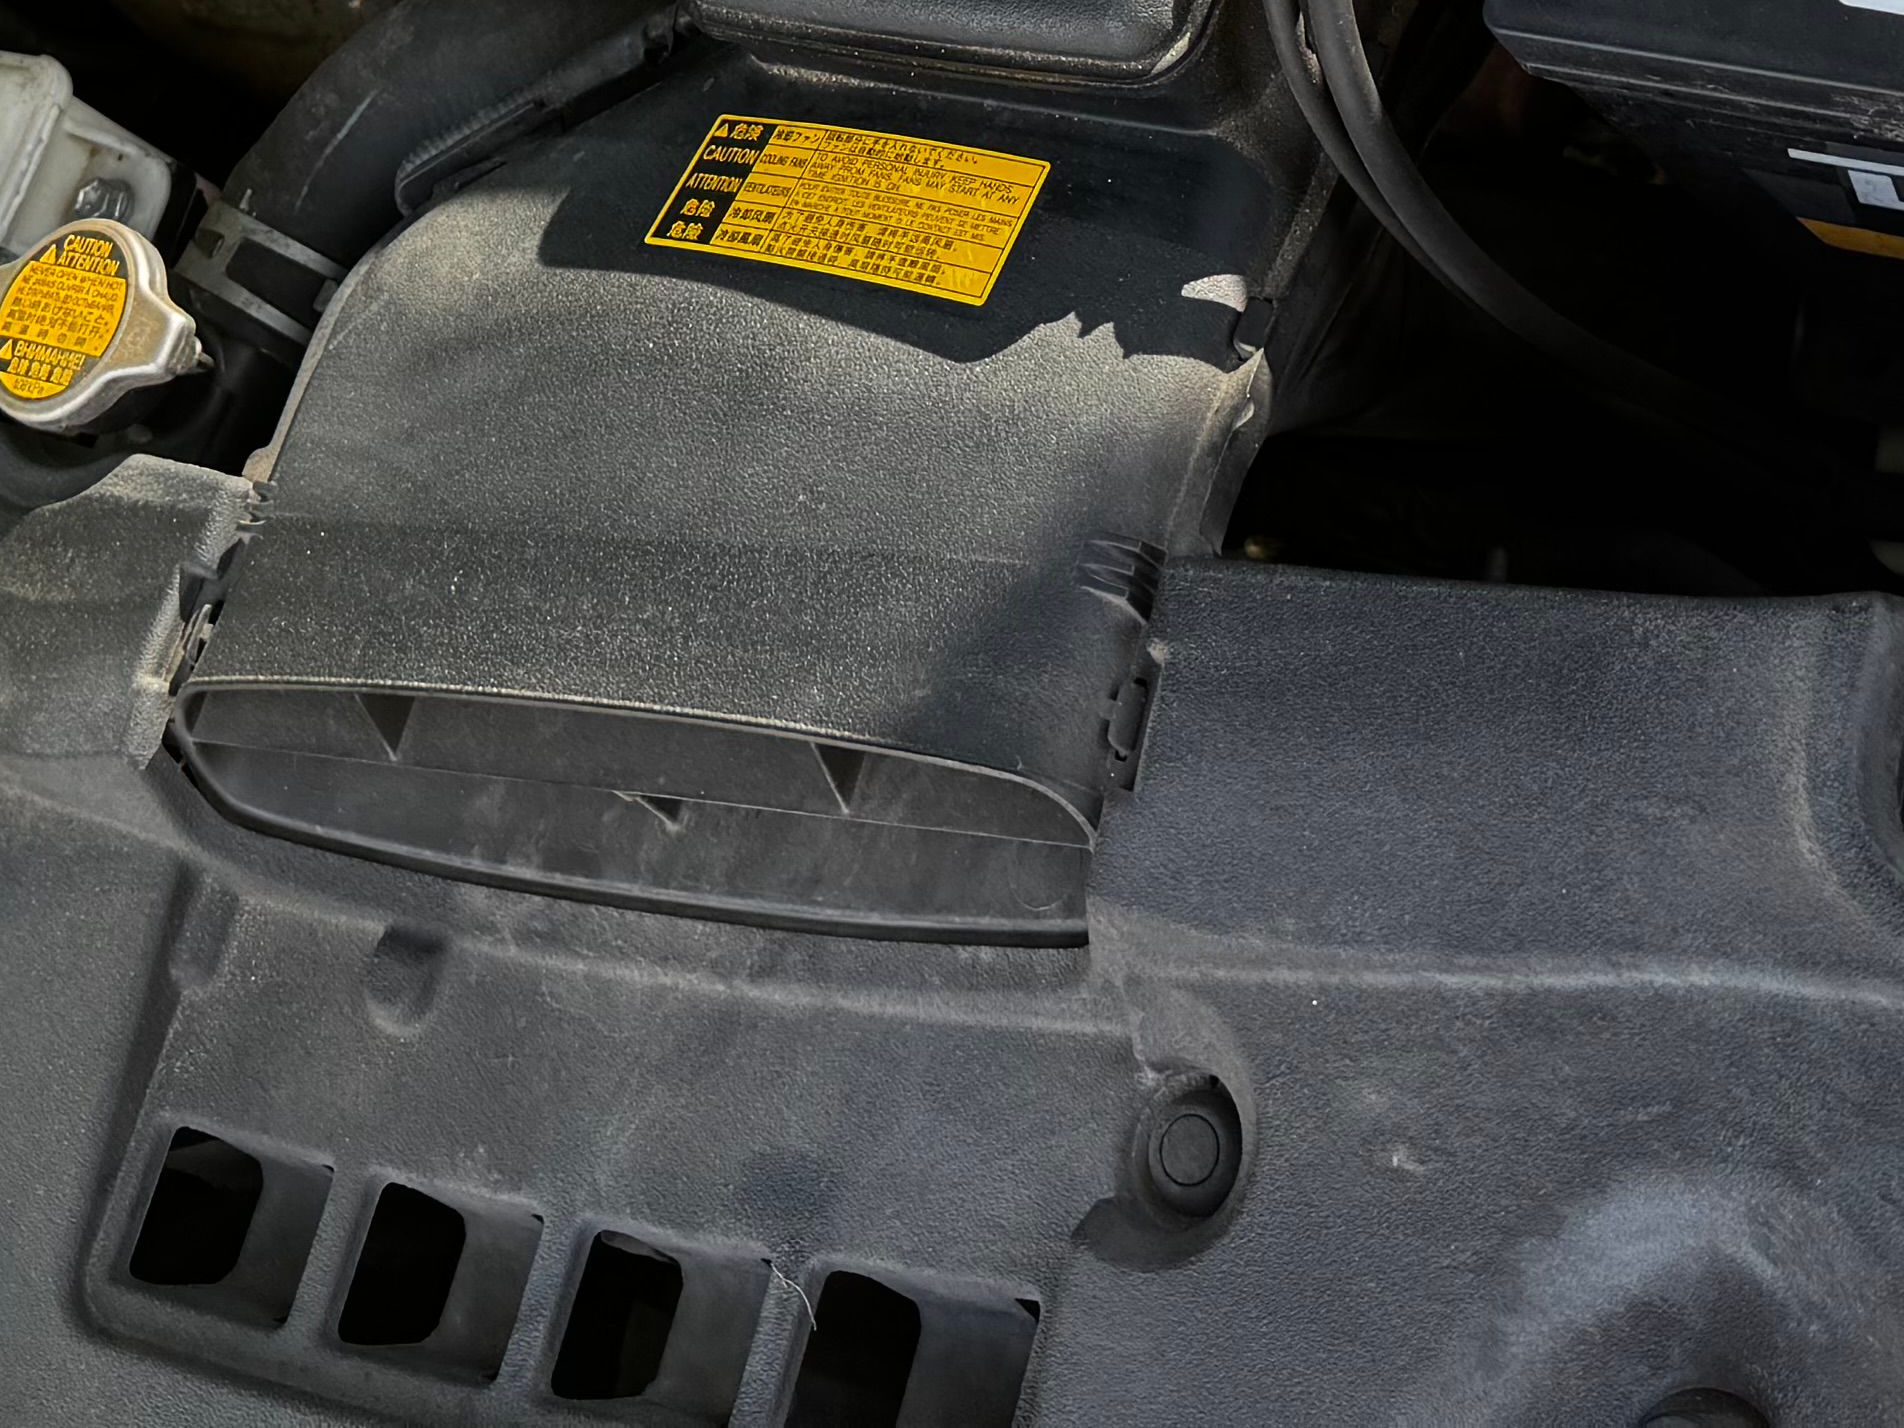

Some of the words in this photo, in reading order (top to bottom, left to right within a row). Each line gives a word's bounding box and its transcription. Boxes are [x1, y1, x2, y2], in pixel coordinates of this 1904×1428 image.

[703, 145, 760, 165] CAUTION
[685, 172, 743, 193] ATTENTION
[811, 162, 834, 171] AWAY
[838, 163, 864, 174] FROM
[925, 179, 947, 191] MAY
[948, 184, 980, 197] START
[981, 190, 996, 199] AT
[997, 194, 1020, 205] ANY
[816, 153, 828, 162] TO
[832, 156, 858, 165] AVOID
[862, 158, 908, 174] PERSONAL
[950, 176, 976, 186] KEEP
[980, 180, 1013, 194] HANDS
[64, 234, 113, 258] CAUTION
[56, 250, 120, 276] ATTENTION
